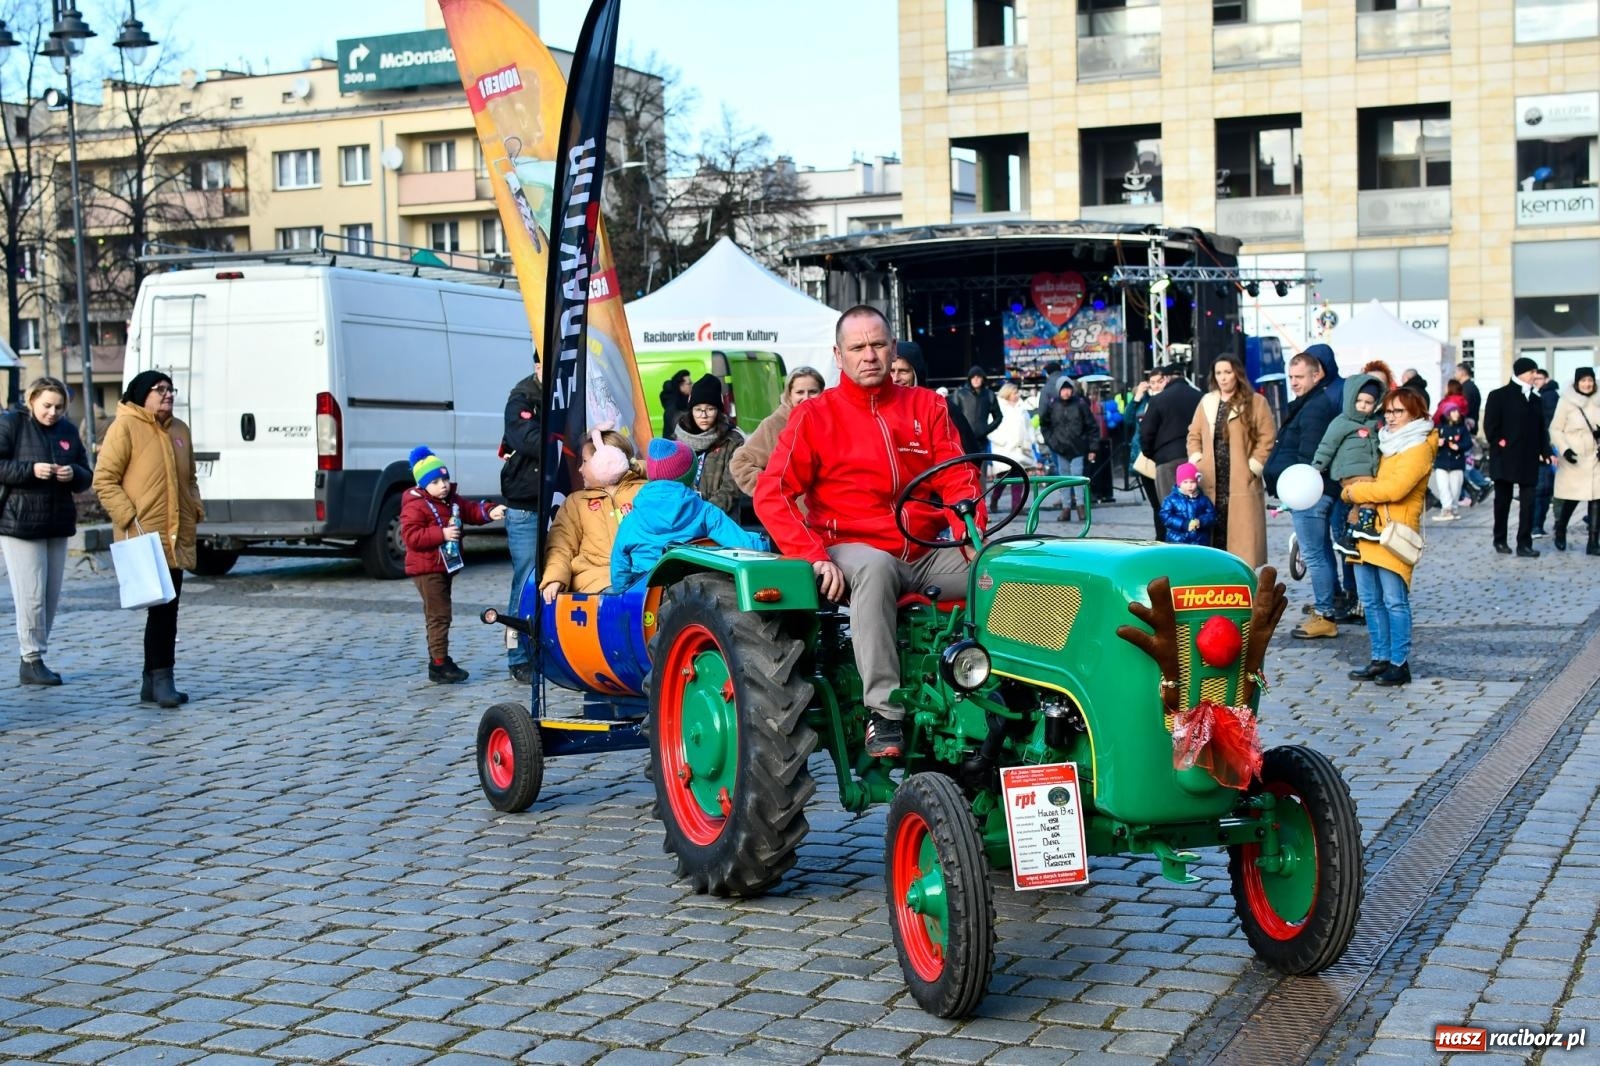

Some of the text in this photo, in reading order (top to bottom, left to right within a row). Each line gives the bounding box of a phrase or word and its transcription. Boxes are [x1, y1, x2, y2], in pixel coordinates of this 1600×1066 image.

[344, 72, 376, 84] 300 m
[643, 331, 695, 343] Raciborskie
[746, 329, 778, 343] Kultury
[1070, 324, 1102, 348] 33
[1177, 590, 1249, 607] Holder
[1015, 791, 1036, 809] rpt
